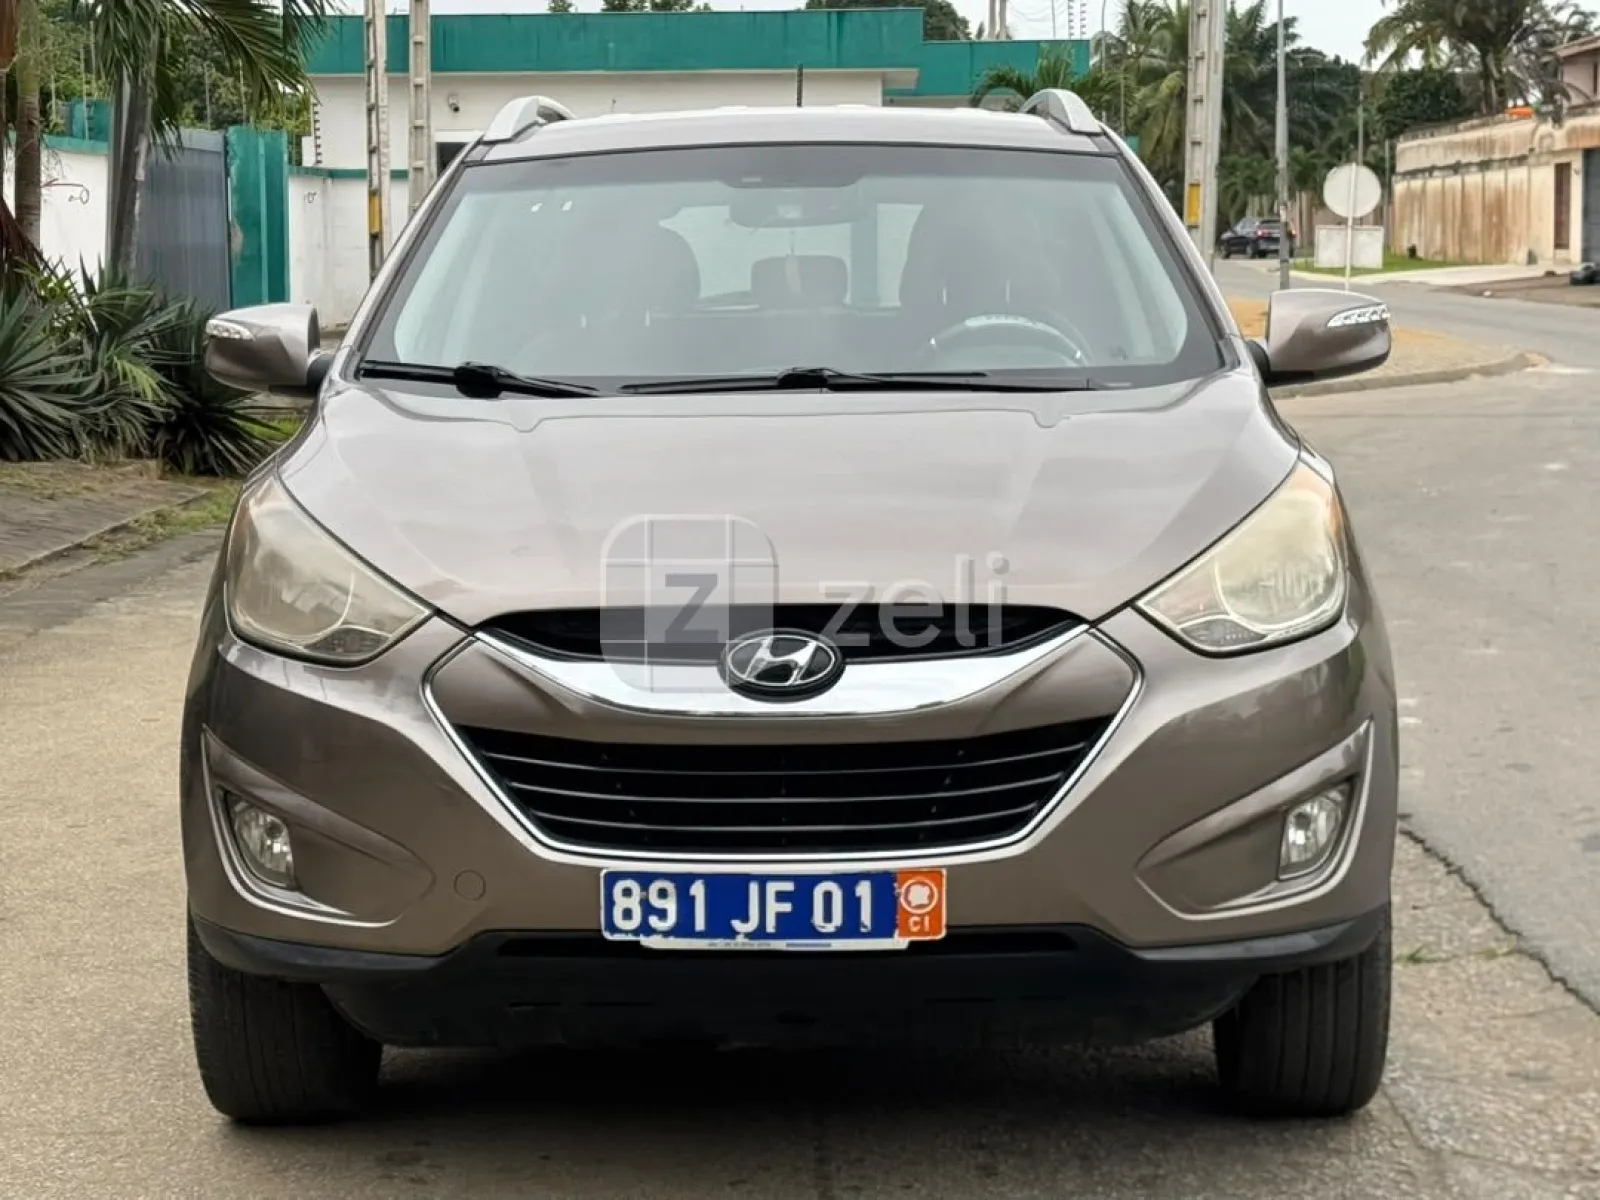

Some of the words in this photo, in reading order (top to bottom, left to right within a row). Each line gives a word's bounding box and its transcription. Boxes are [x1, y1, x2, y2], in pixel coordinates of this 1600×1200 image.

[612, 878, 706, 933] 891
[731, 880, 795, 934] JF
[812, 879, 873, 934] 01
[908, 914, 930, 933] CI
